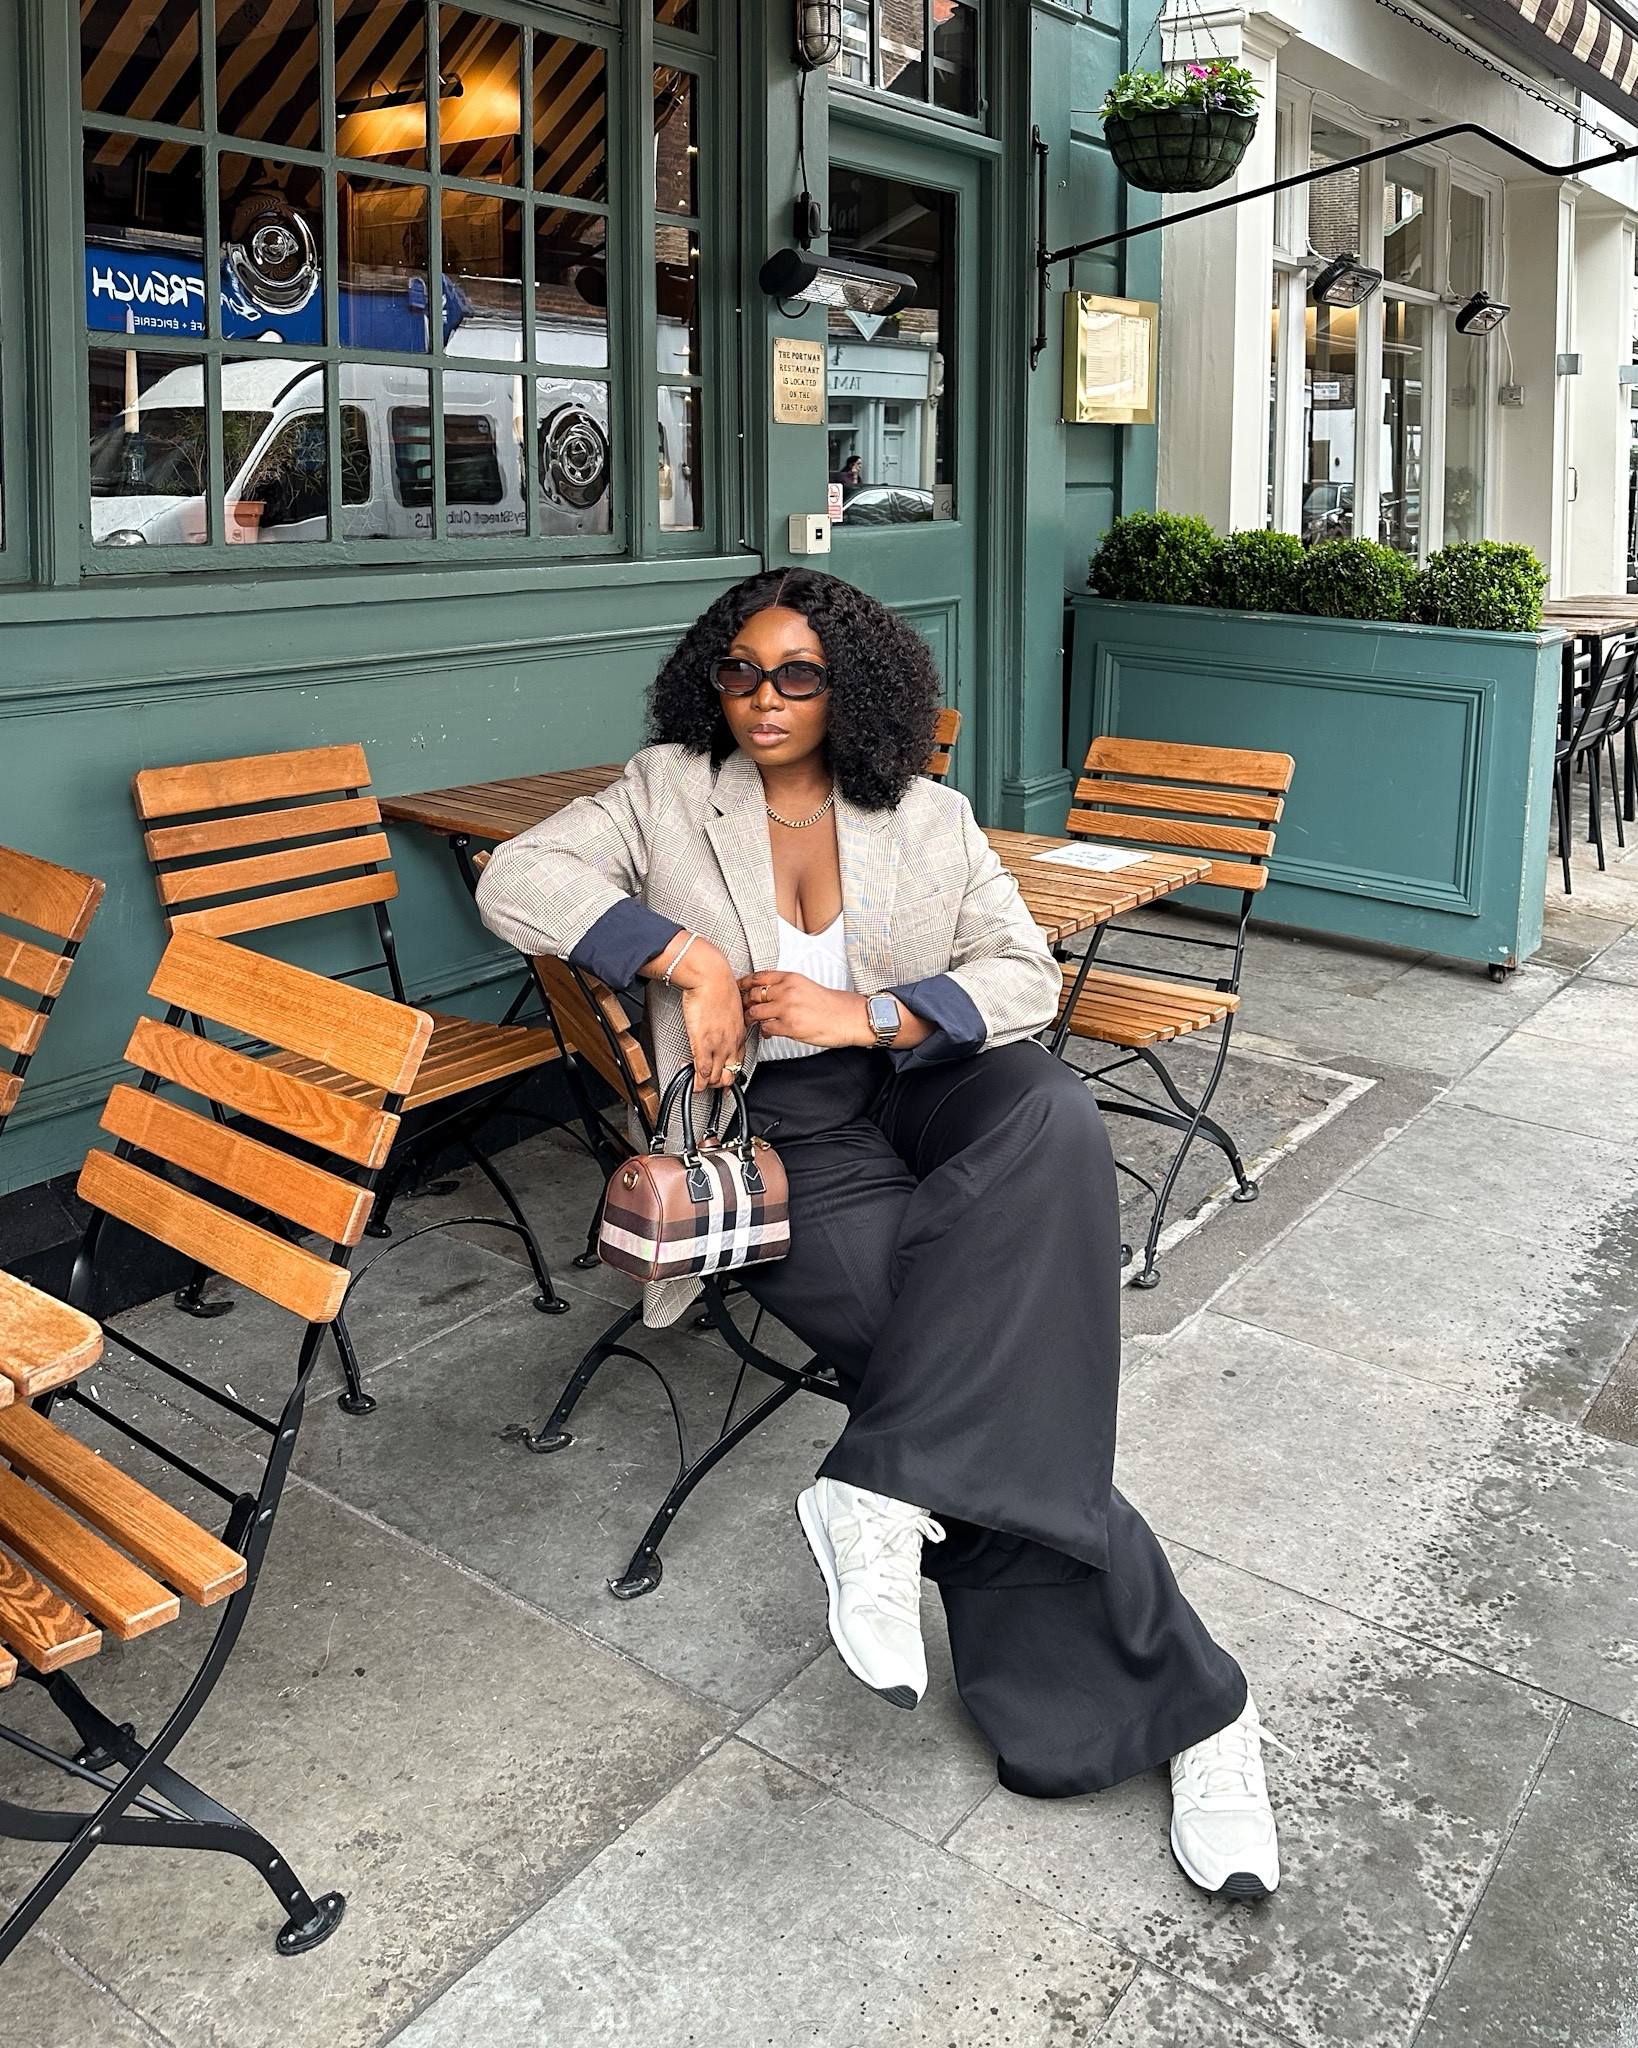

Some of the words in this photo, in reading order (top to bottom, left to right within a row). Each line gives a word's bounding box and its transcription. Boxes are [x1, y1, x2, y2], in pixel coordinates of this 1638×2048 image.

[778, 350, 791, 359] THE
[791, 352, 821, 362] PORTMAN
[779, 363, 820, 375] RESTAURANT
[782, 377, 789, 385] IS
[790, 378, 817, 387] LOCATED
[789, 390, 797, 398] ON
[799, 391, 810, 399] THE
[781, 403, 799, 411] FIRST
[800, 404, 818, 412] FLOOR
